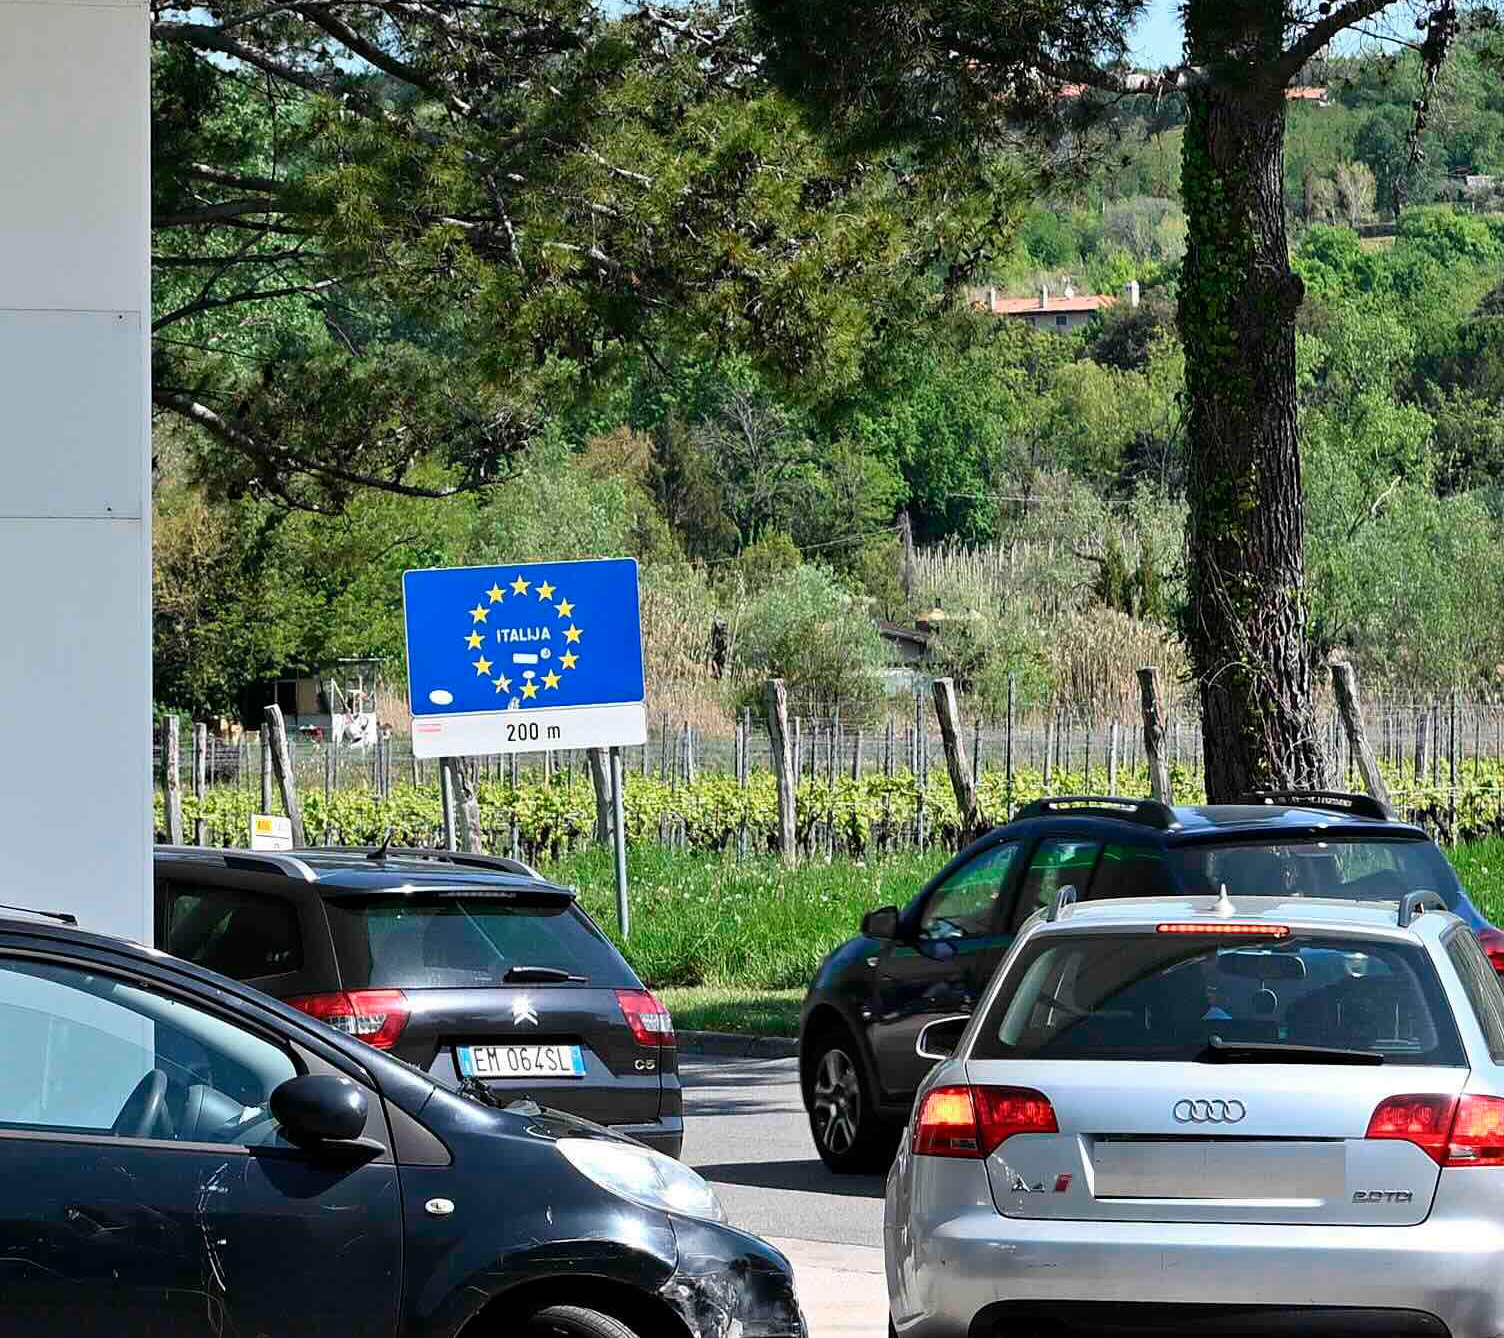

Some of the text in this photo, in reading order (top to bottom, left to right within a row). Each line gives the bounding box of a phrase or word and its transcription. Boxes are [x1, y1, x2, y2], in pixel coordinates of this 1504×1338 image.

[496, 626, 551, 643] ITALIJA
[506, 722, 561, 742] 200 m
[474, 1047, 571, 1072] EM 064SL
[634, 1059, 656, 1070] C5
